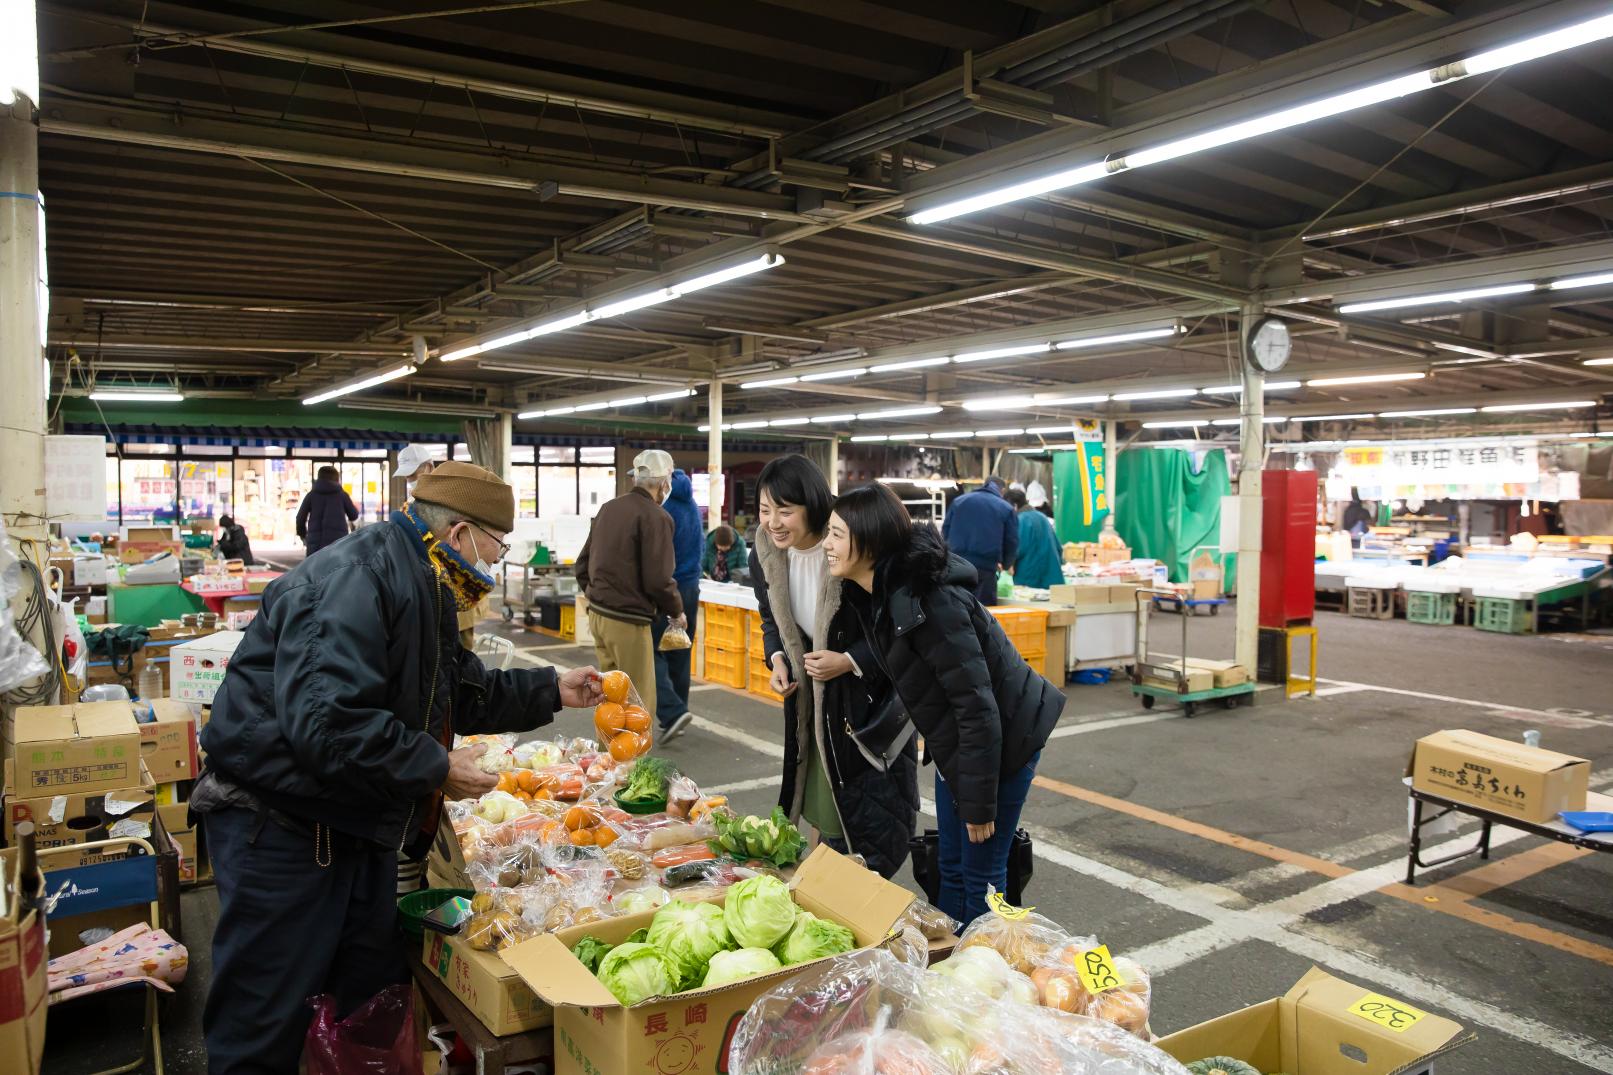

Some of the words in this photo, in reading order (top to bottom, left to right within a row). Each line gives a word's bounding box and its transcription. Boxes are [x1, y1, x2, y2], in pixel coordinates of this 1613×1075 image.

[72, 773, 88, 782] 5kg
[1084, 951, 1119, 990] 550
[644, 1002, 708, 1037] 長崎
[1359, 1002, 1417, 1028] 320
